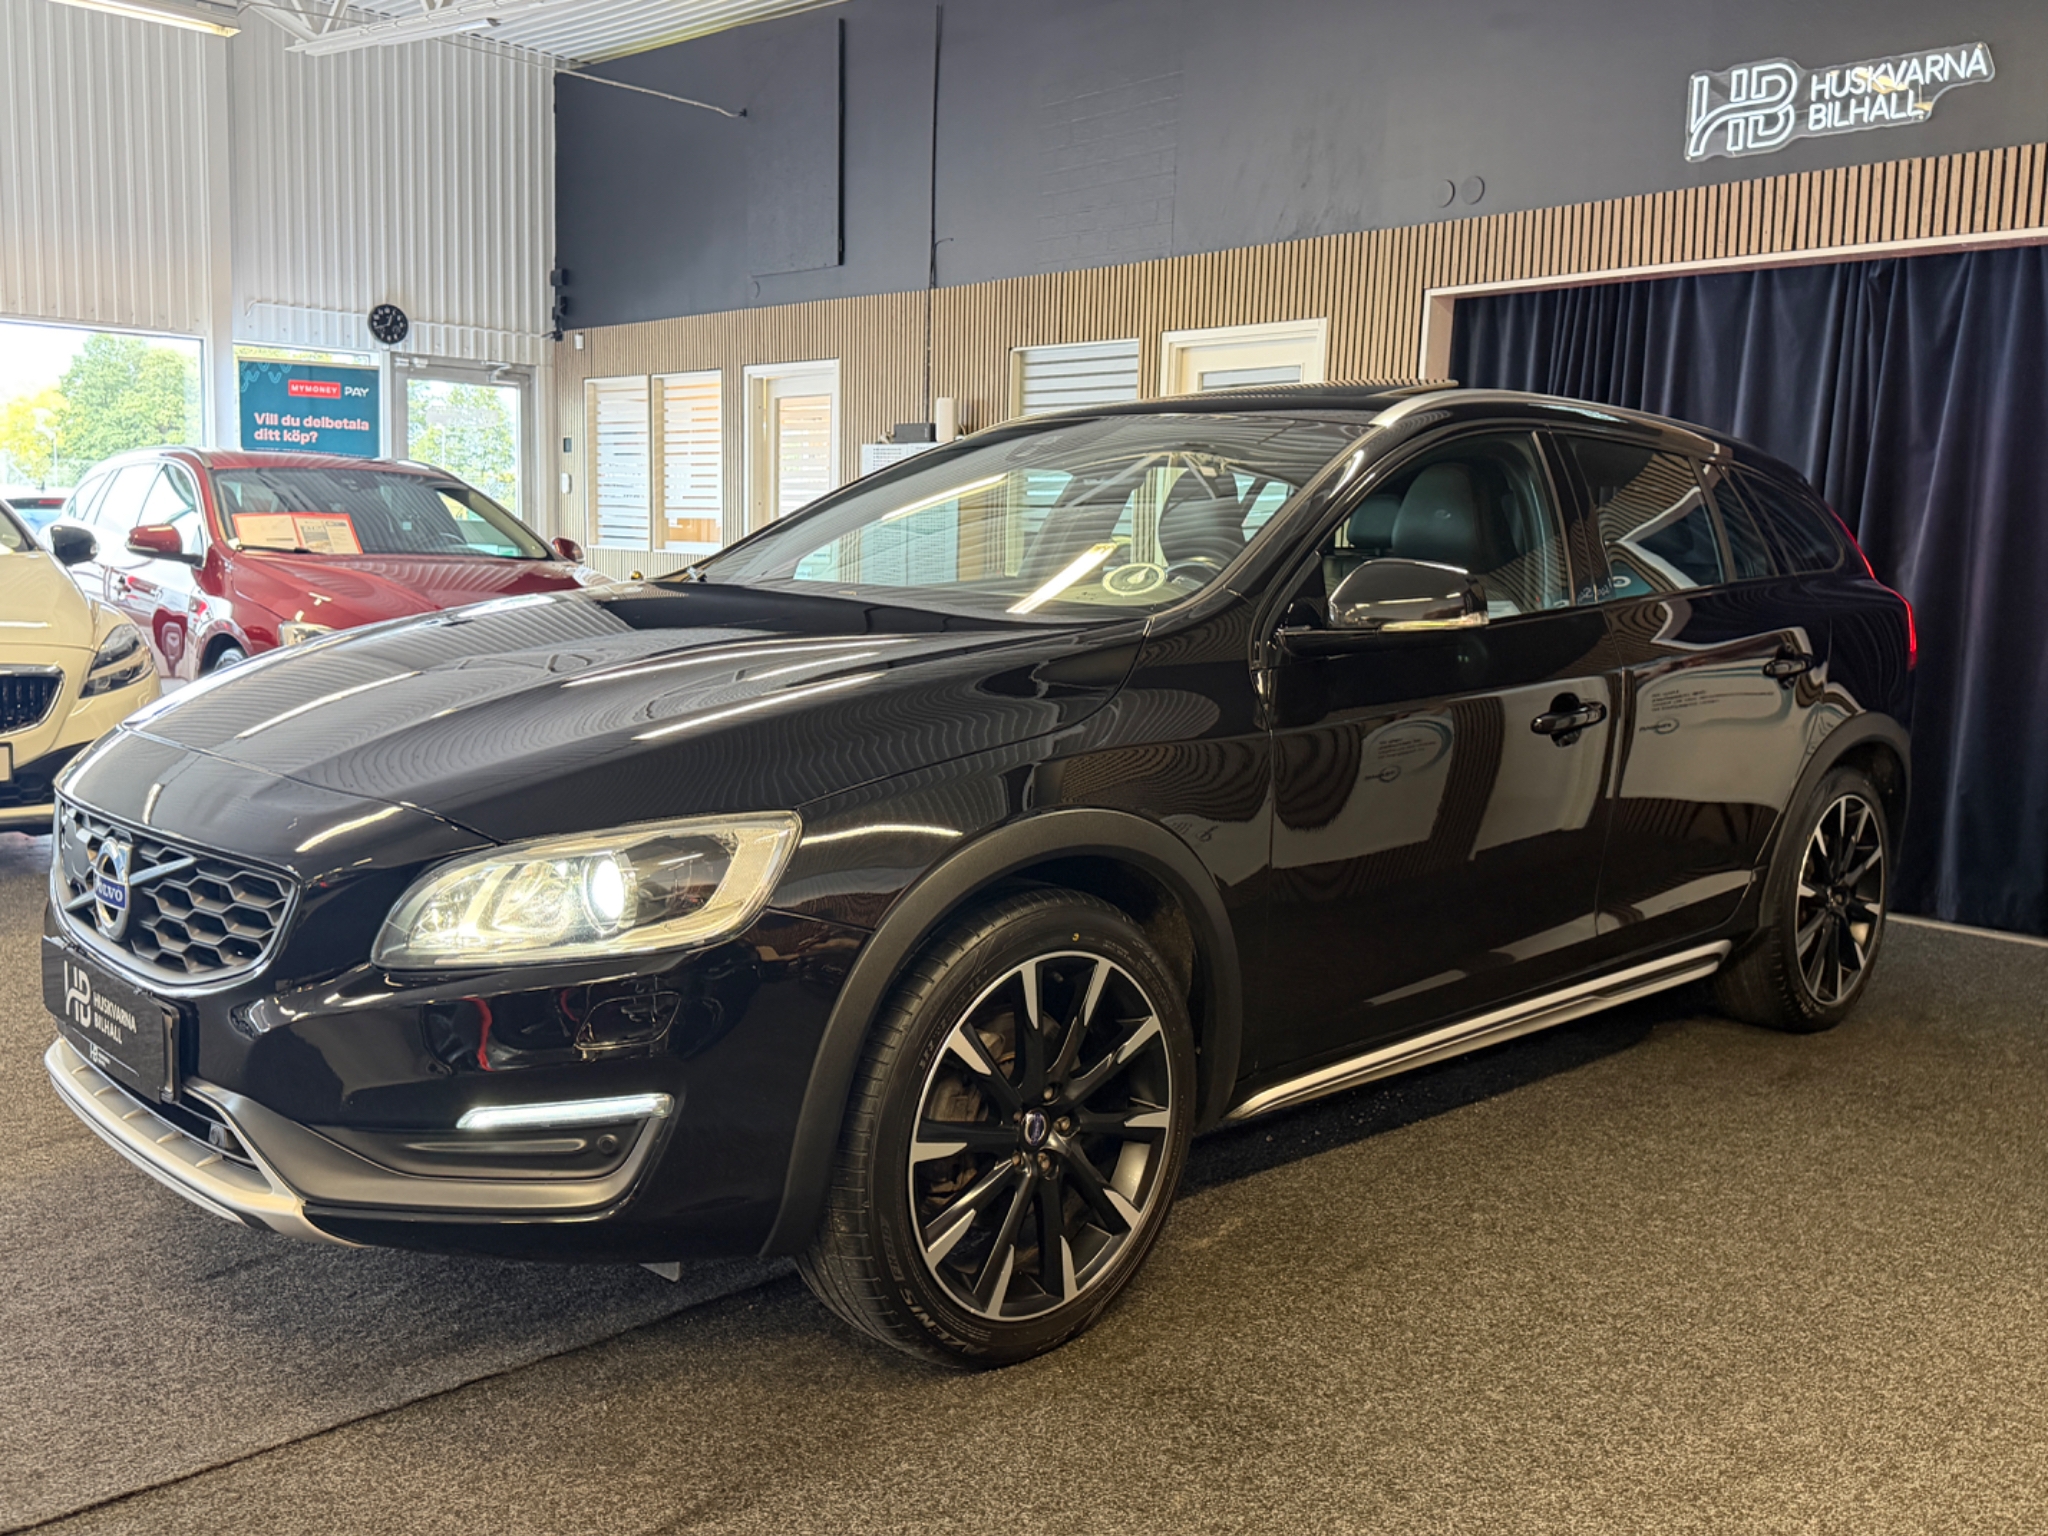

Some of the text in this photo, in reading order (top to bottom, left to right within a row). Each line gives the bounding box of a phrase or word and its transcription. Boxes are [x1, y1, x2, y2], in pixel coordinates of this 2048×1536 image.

[1810, 48, 1988, 102] HUSKVARNA
[1808, 89, 1924, 131] BILHALL
[291, 383, 370, 397] MYMONEY PAY
[254, 412, 370, 431] Vill du delbetala
[254, 428, 319, 445] ditt köp?
[97, 880, 123, 903] OLVO
[93, 991, 137, 1034] HUSKVARNA
[94, 1012, 122, 1045] BILHALL
